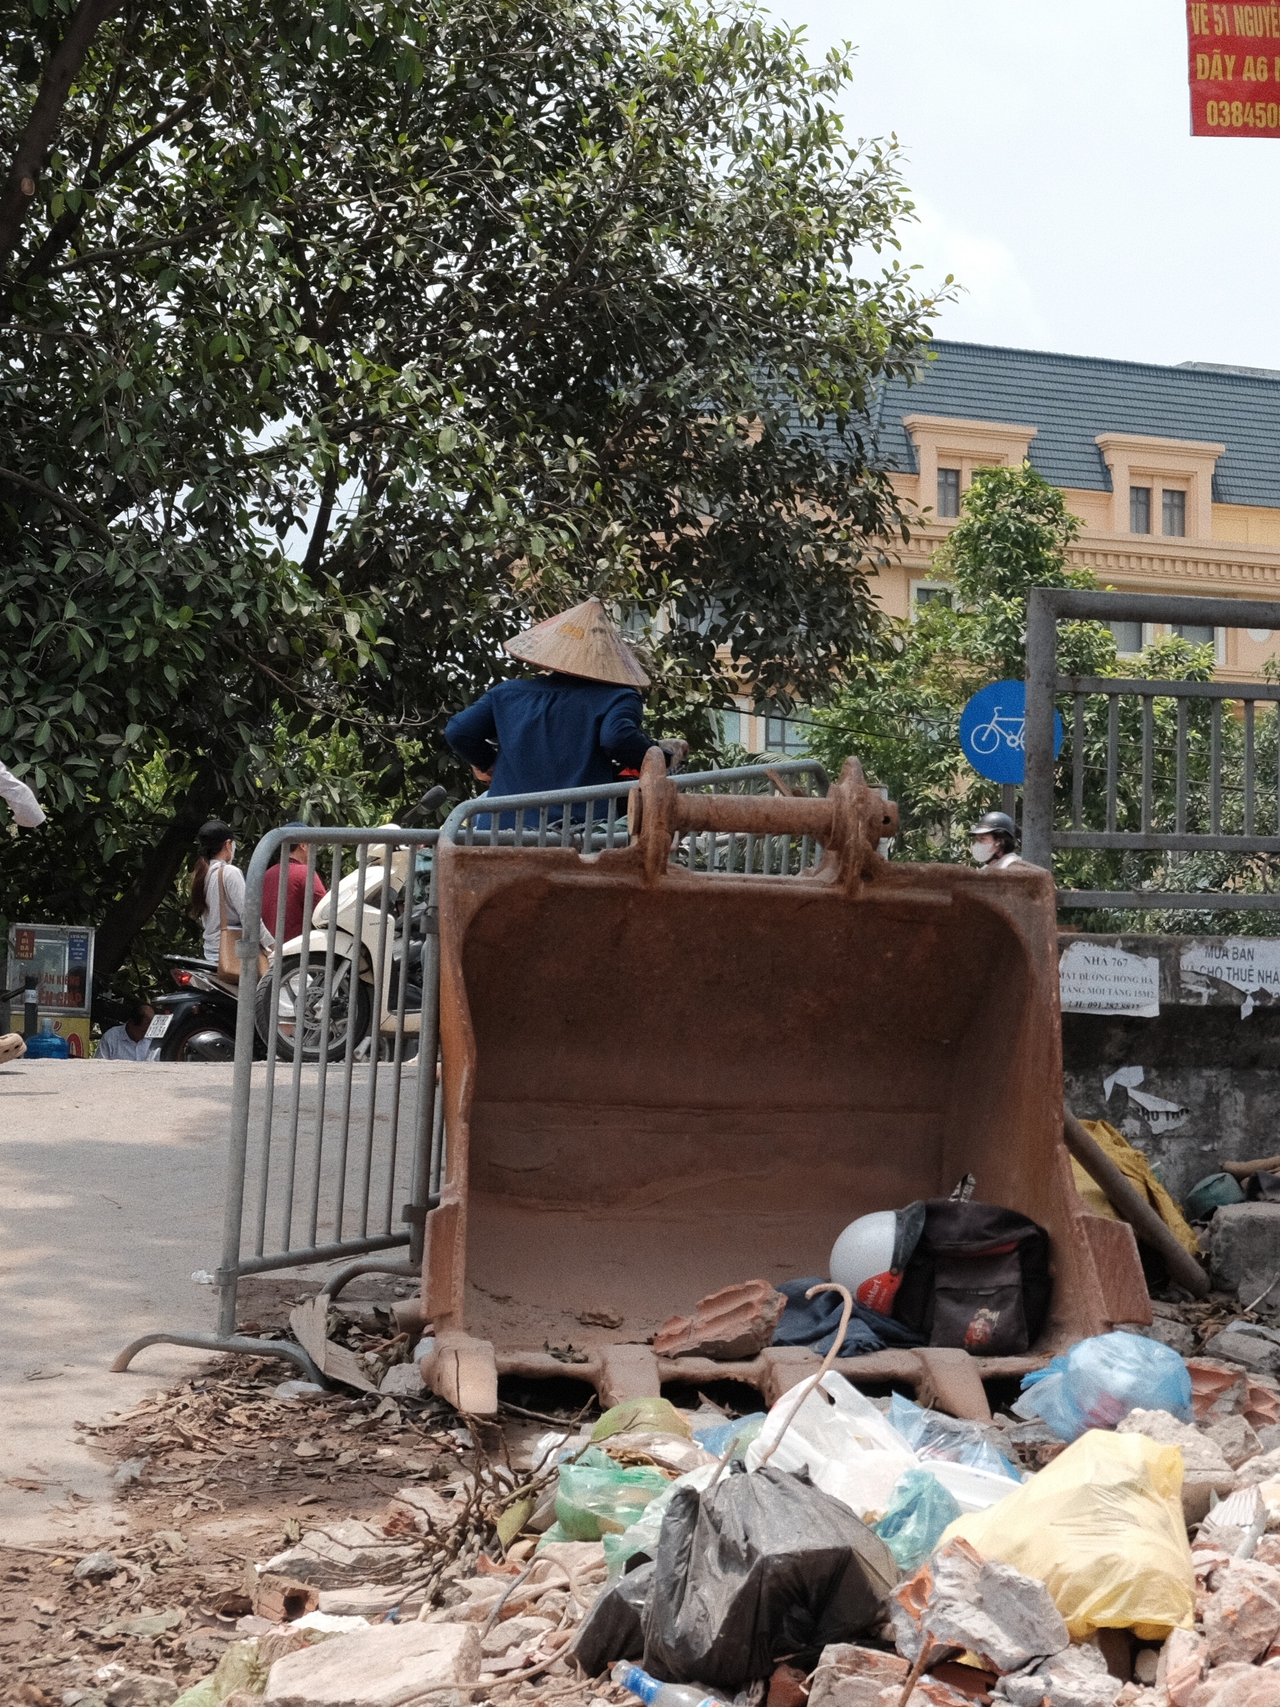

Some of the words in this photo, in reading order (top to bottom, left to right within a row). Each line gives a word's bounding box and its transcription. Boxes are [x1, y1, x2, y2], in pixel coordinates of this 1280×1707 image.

[1214, 4, 1231, 36] 51
[1196, 49, 1236, 81] DÃY
[1242, 55, 1269, 82] A6
[1084, 954, 1108, 967] NHÀ
[1111, 957, 1128, 968] 767
[1257, 966, 1280, 984] NHÀ
